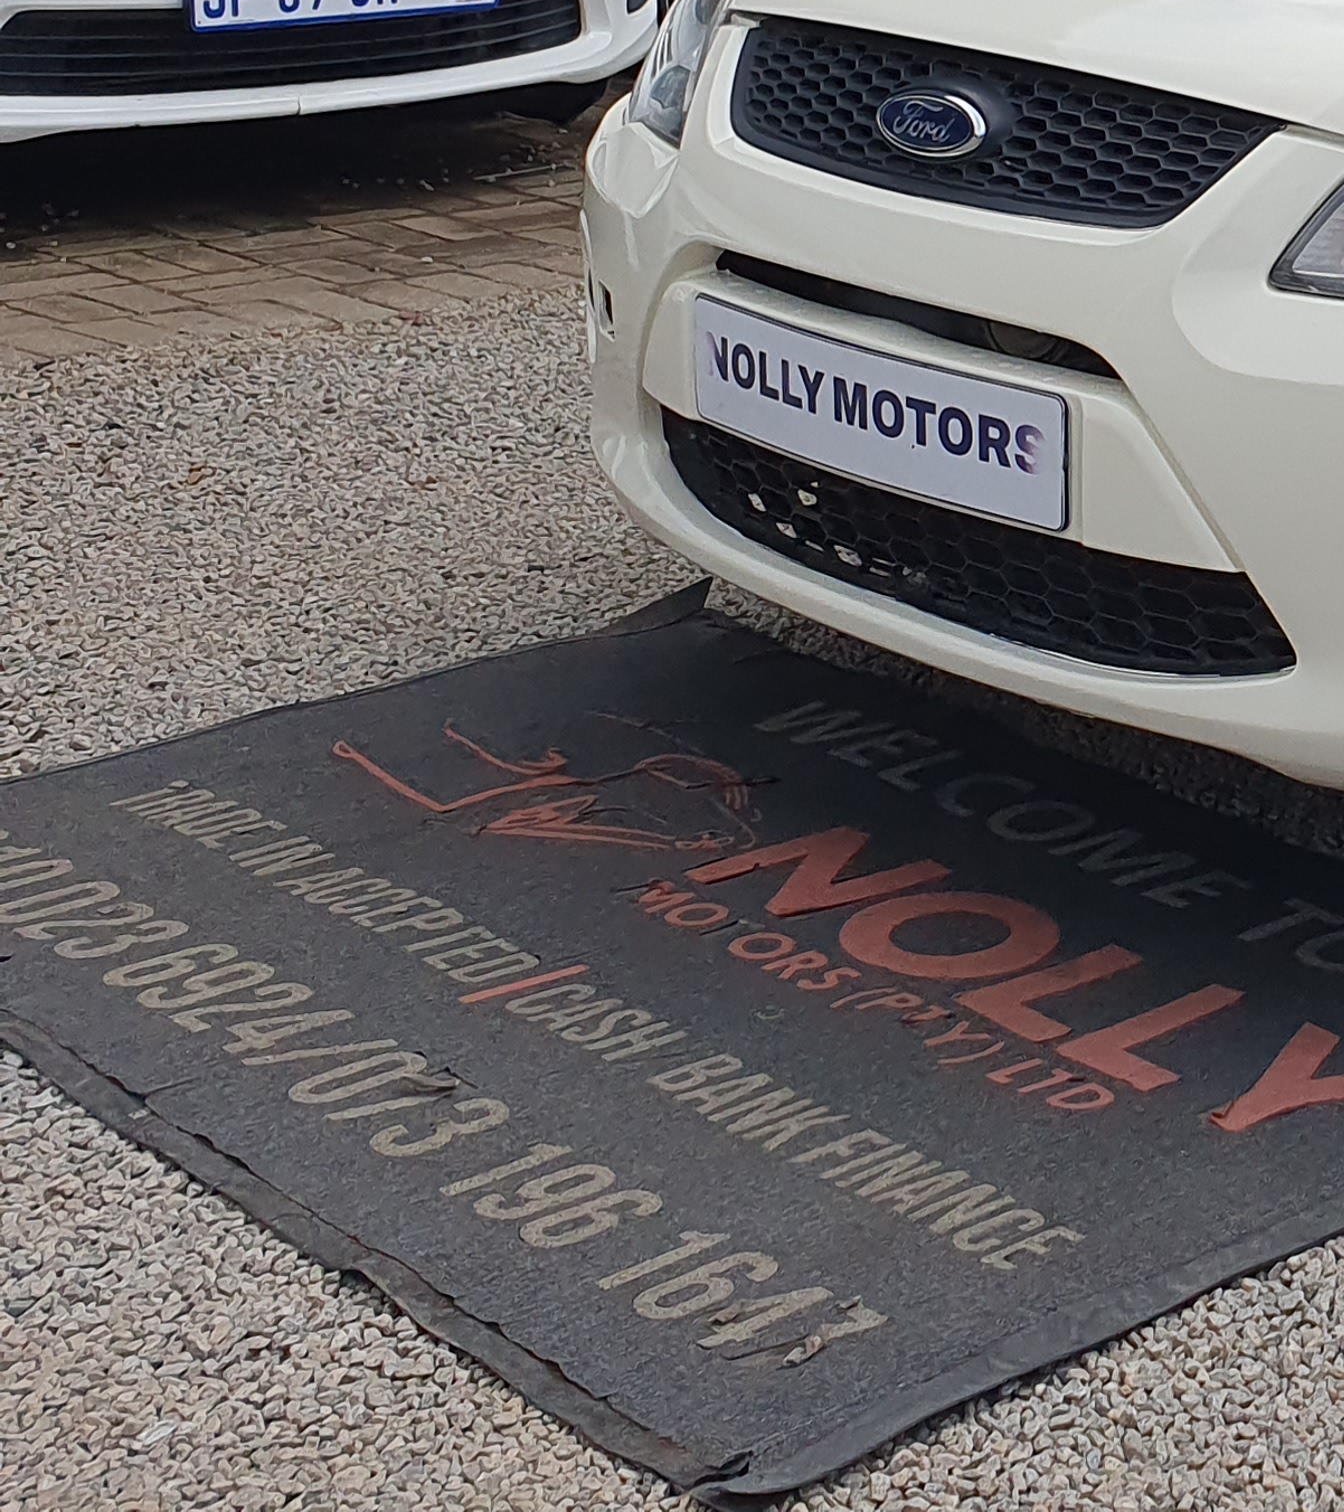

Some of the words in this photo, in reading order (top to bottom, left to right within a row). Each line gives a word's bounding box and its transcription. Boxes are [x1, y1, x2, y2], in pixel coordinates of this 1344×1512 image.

[892, 99, 956, 143] Ford
[705, 330, 825, 415] NOLLY
[833, 376, 1047, 475] MOTORS
[752, 699, 1252, 909] WELCOME
[228, 835, 336, 876] IN
[646, 1053, 851, 1152] BANK
[786, 1128, 1087, 1270] FINANCE
[985, 1057, 1116, 1111] LTD
[438, 1142, 664, 1249] 196
